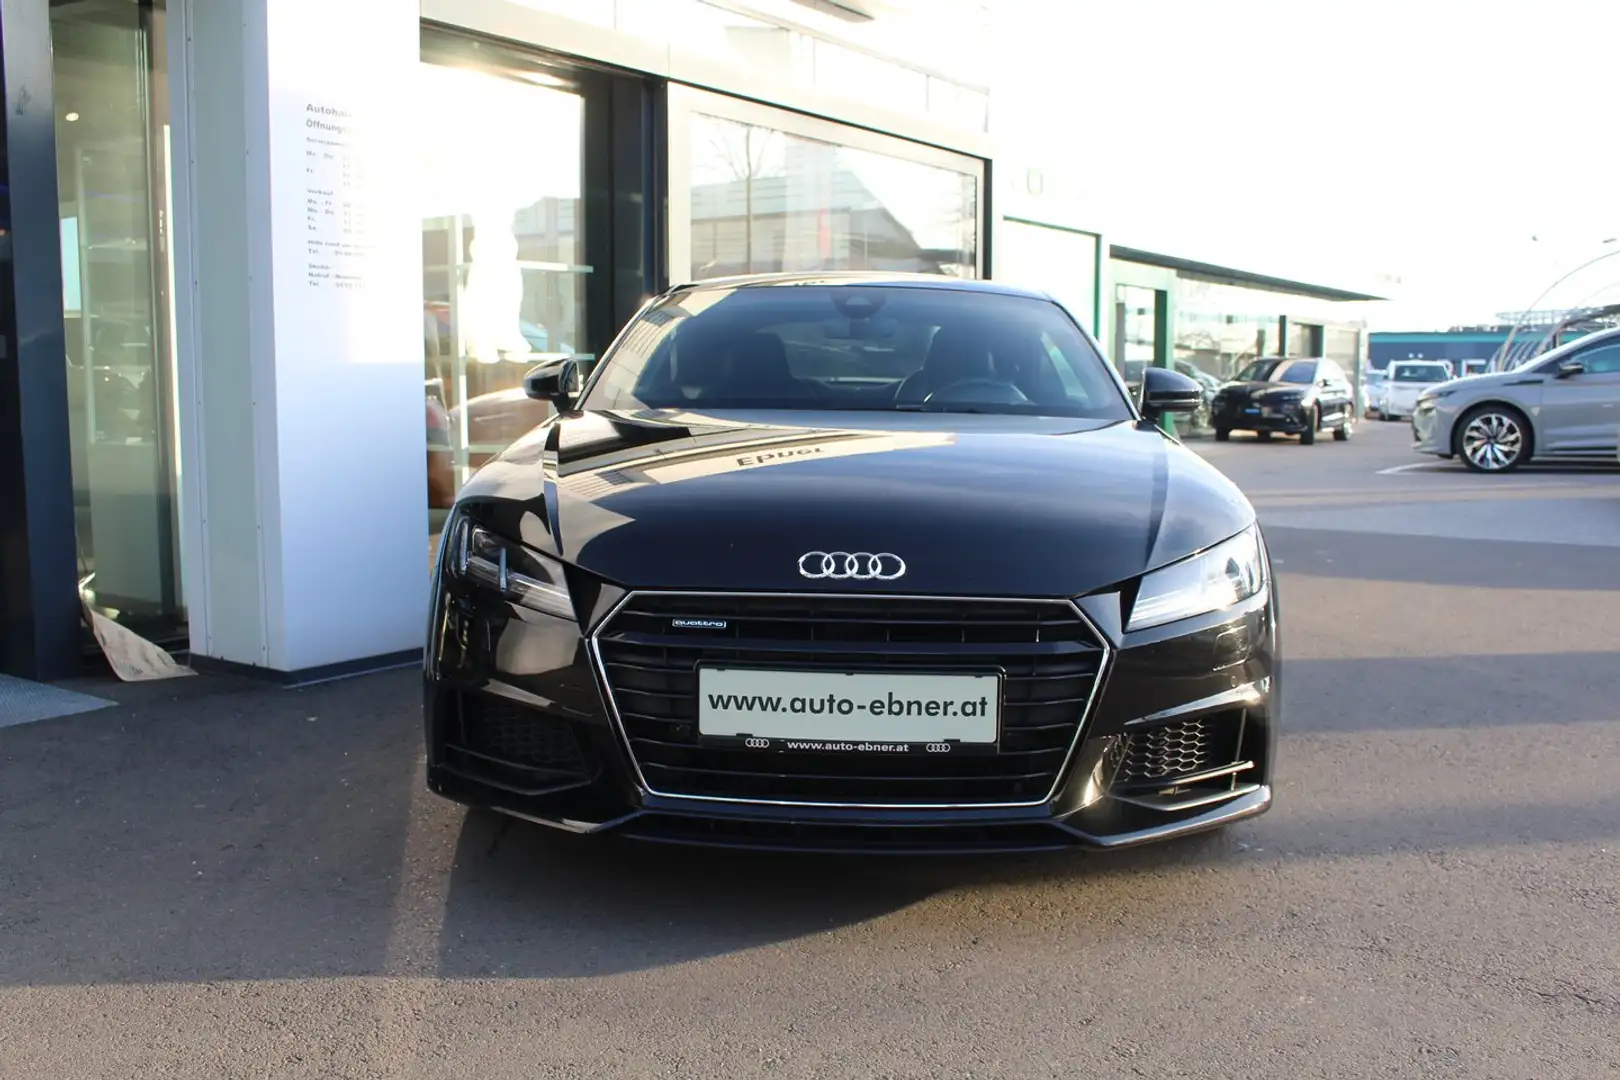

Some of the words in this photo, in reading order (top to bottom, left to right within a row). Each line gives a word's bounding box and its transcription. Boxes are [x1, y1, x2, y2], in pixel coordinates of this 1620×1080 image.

[673, 619, 726, 628] quattro
[708, 692, 988, 717] www.auto-ebner.at
[787, 740, 909, 753] www.auto-ebner.at
